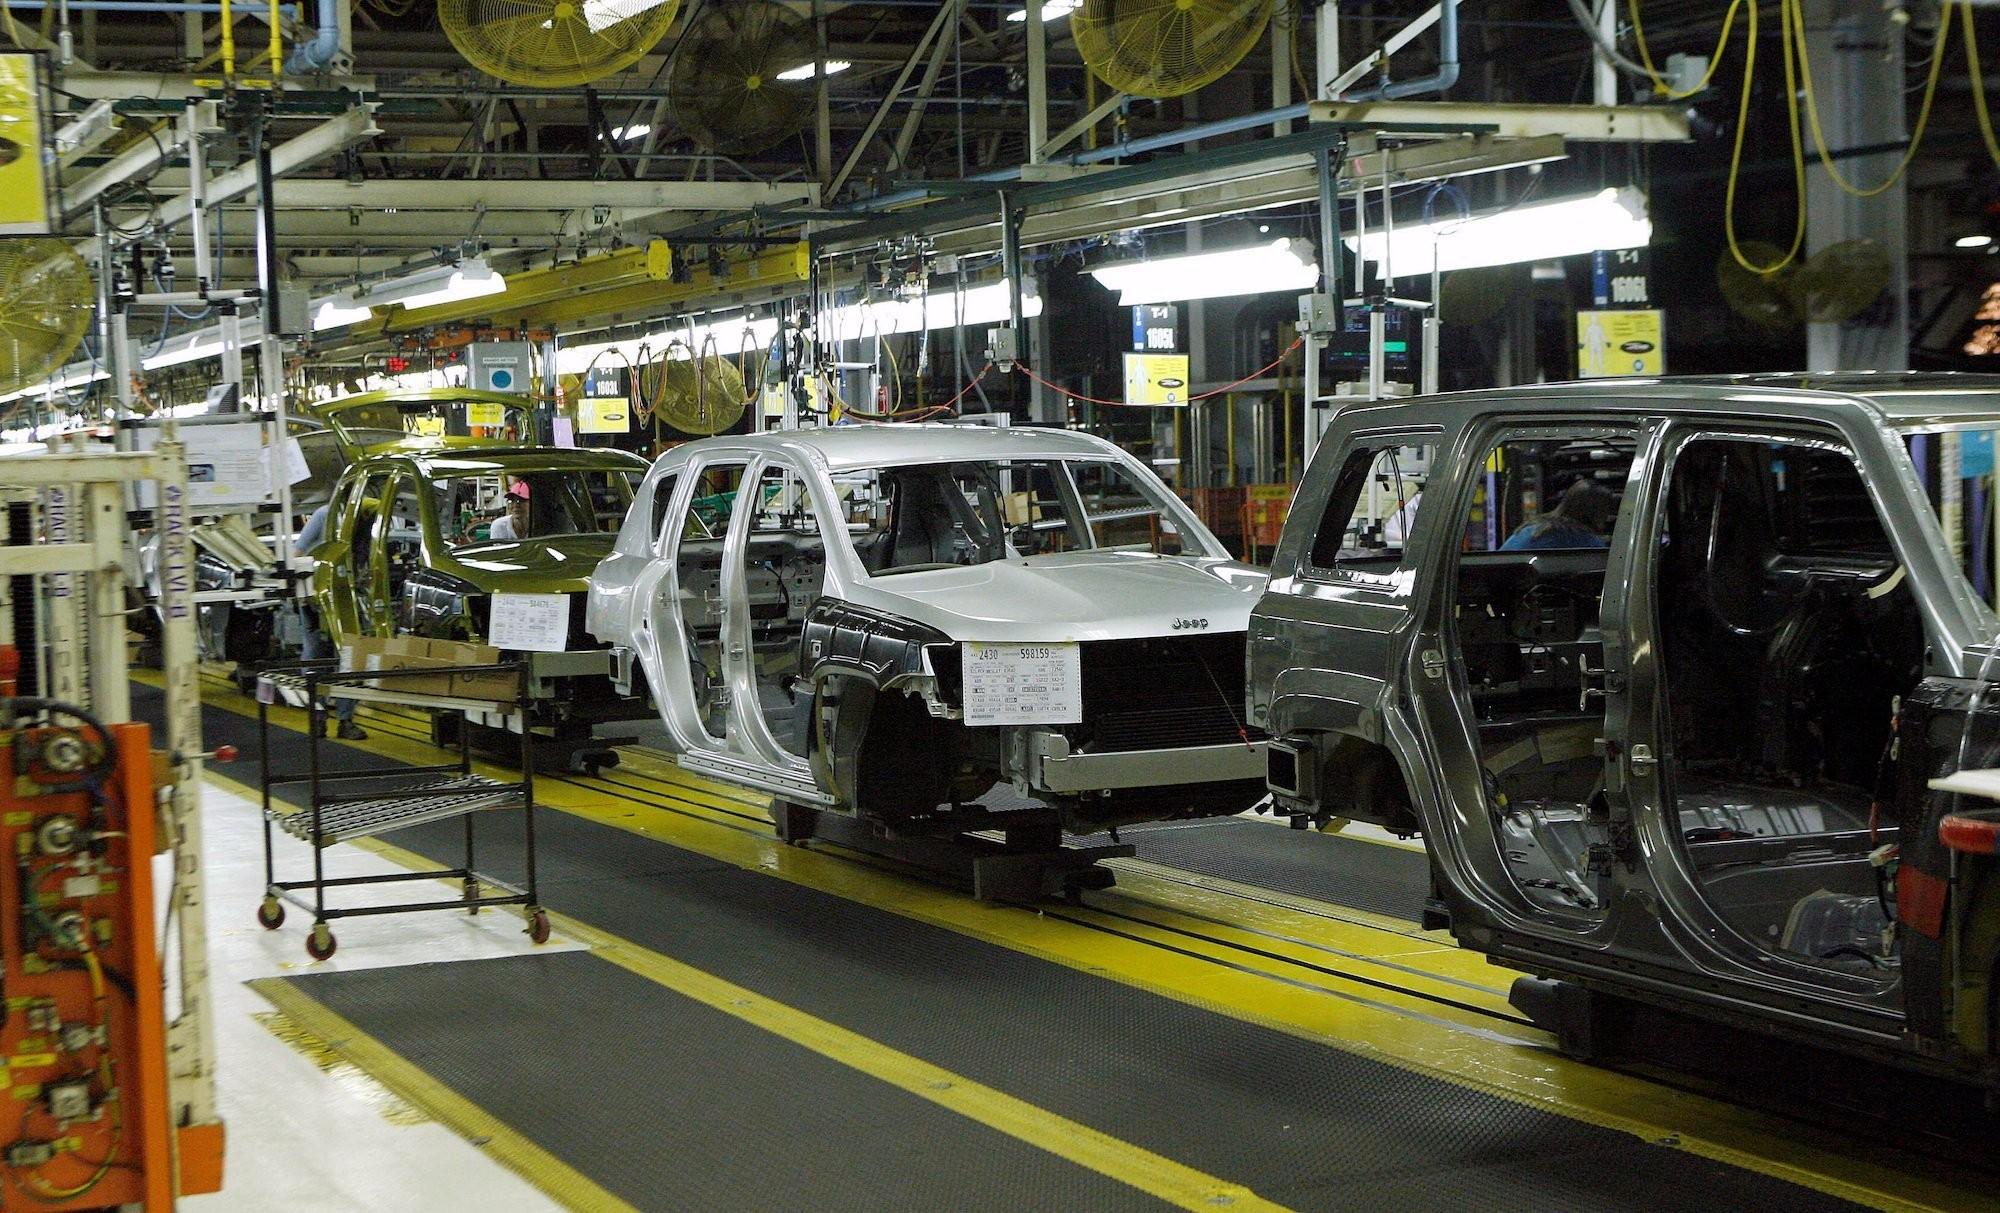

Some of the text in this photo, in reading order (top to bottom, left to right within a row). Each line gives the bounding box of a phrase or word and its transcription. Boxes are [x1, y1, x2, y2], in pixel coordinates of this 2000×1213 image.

[1616, 250, 1638, 263] T-1
[1151, 307, 1168, 318] T-1
[1172, 618, 1208, 630] Jeep
[979, 649, 999, 660] 2430
[1020, 648, 1049, 659] 598159
